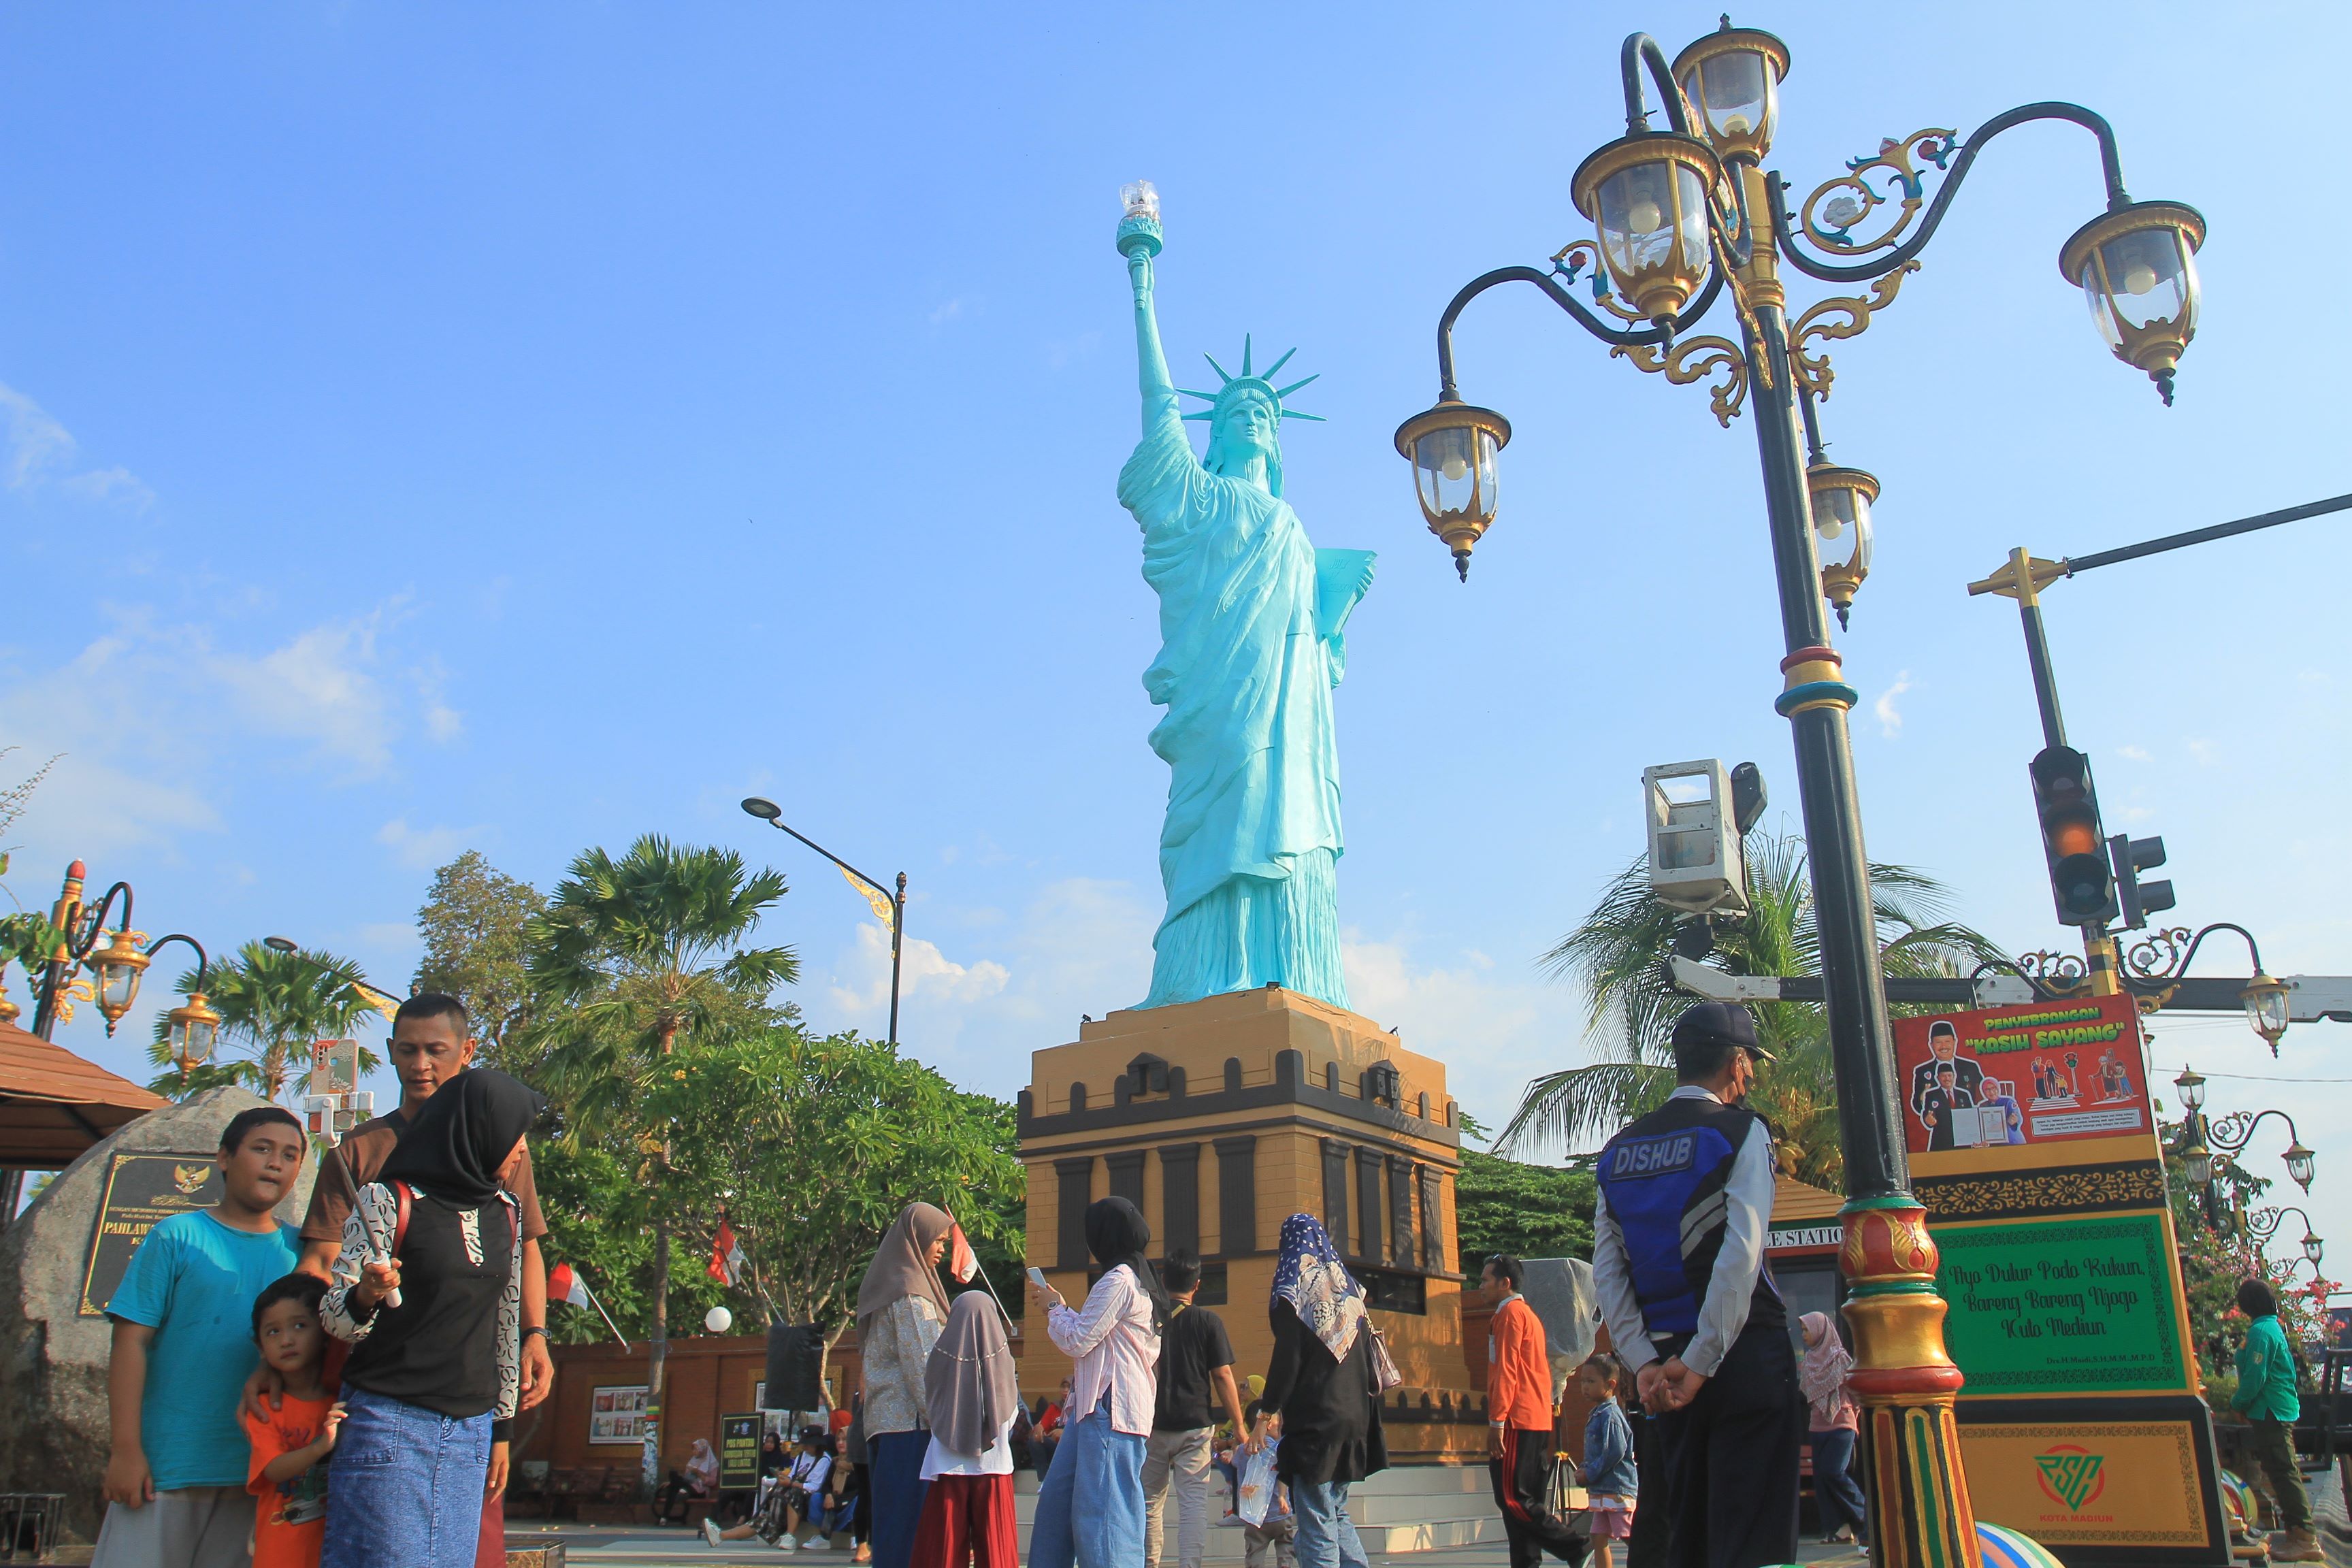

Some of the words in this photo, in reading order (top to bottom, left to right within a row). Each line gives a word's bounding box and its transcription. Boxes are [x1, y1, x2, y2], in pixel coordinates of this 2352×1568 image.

[1983, 1007, 2101, 1031] PENYEBRANGAN
[1614, 1137, 1693, 1174] DISHUB
[1948, 1264, 1982, 1292] Ayo
[1985, 1262, 2033, 1284] Dulur
[1963, 1292, 2022, 1318] Bareng
[2025, 1289, 2086, 1316] Bareng
[2046, 1316, 2107, 1337] Mediun
[2040, 1514, 2068, 1522] KOTA
[2070, 1514, 2113, 1522] MADIUN
